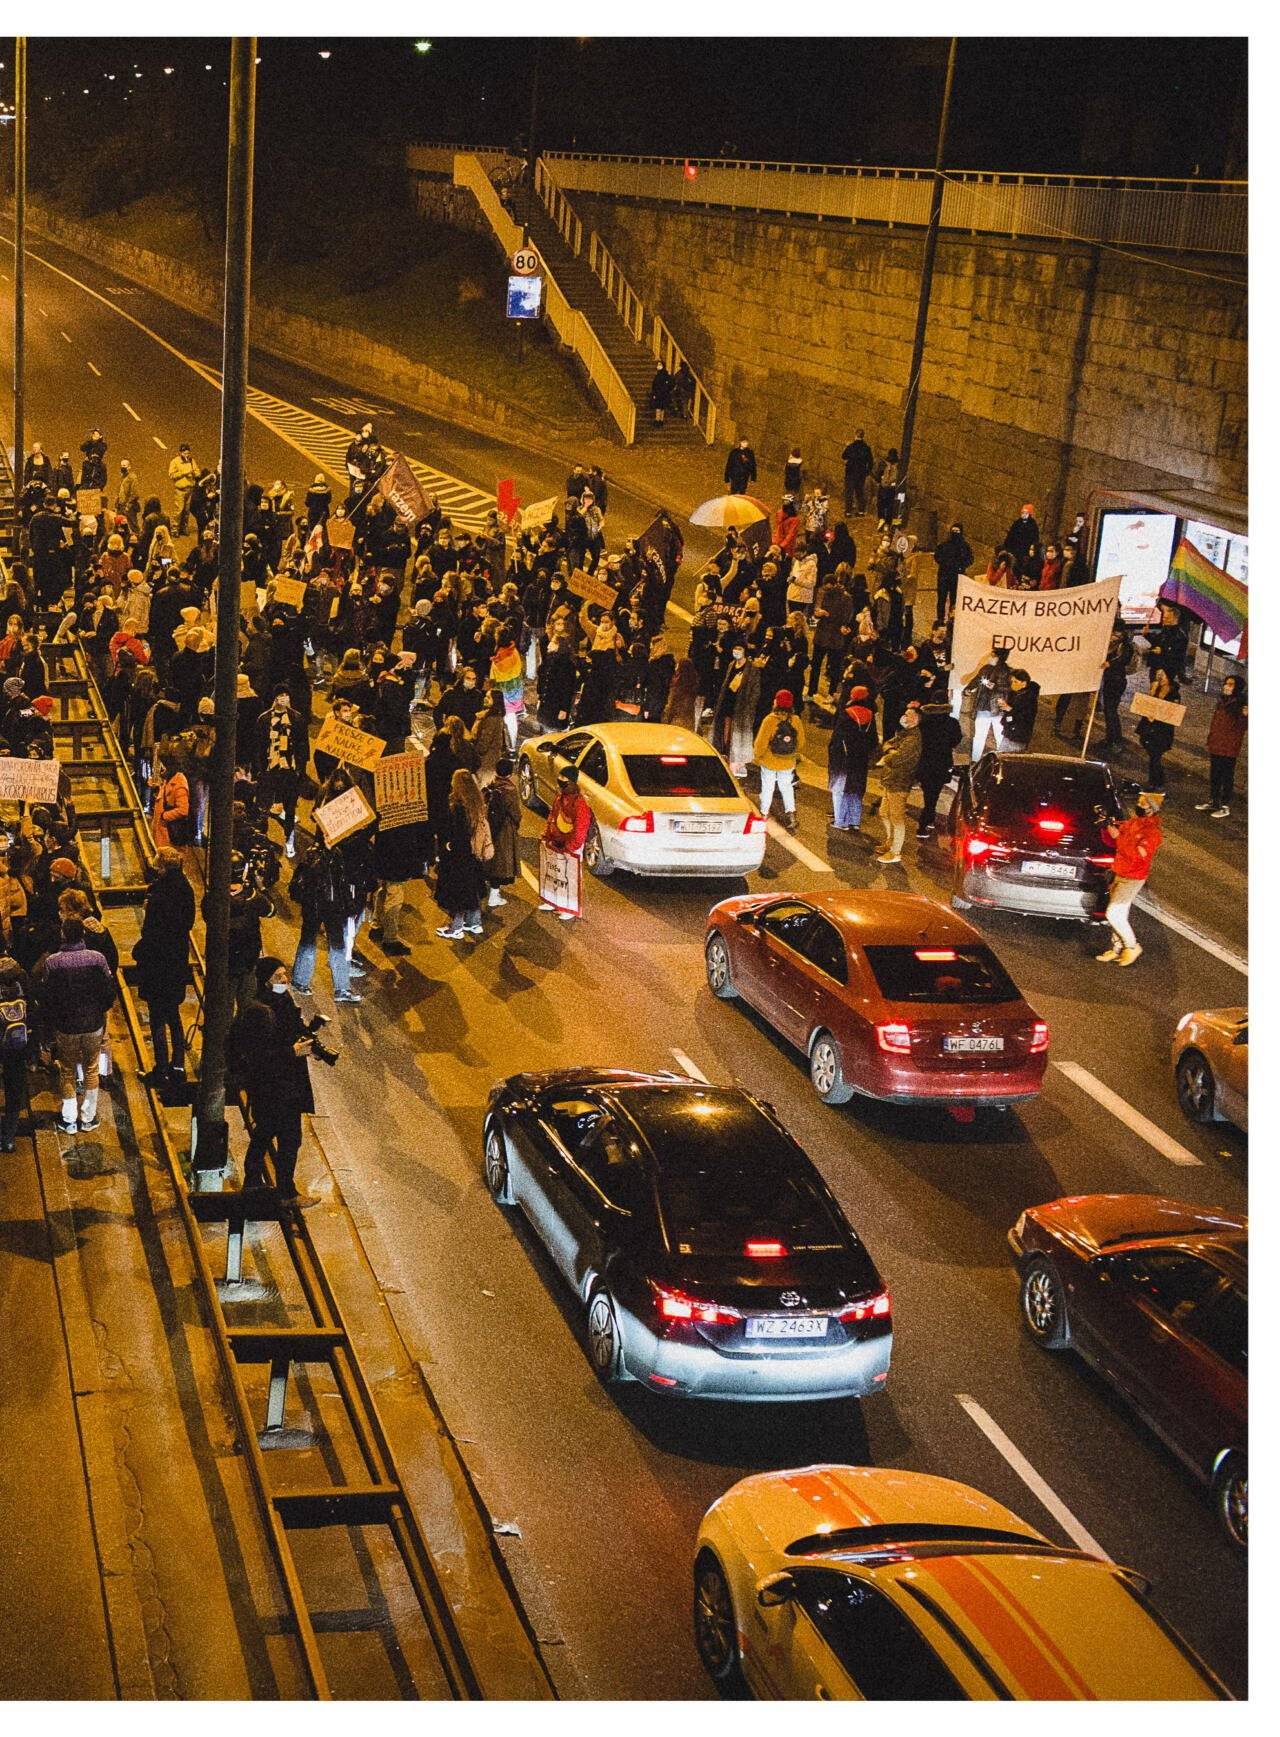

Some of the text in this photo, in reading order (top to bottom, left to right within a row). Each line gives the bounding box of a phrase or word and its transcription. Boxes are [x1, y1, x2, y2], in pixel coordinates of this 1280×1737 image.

[515, 255, 536, 269] 80
[387, 488, 418, 522] razem
[962, 595, 1027, 617] RAZEM
[1034, 597, 1114, 617] BROŃMY
[991, 634, 1081, 652] EDUKACJI
[950, 1039, 1001, 1050] WF 0476L
[756, 1319, 824, 1334] WZ 2463X
